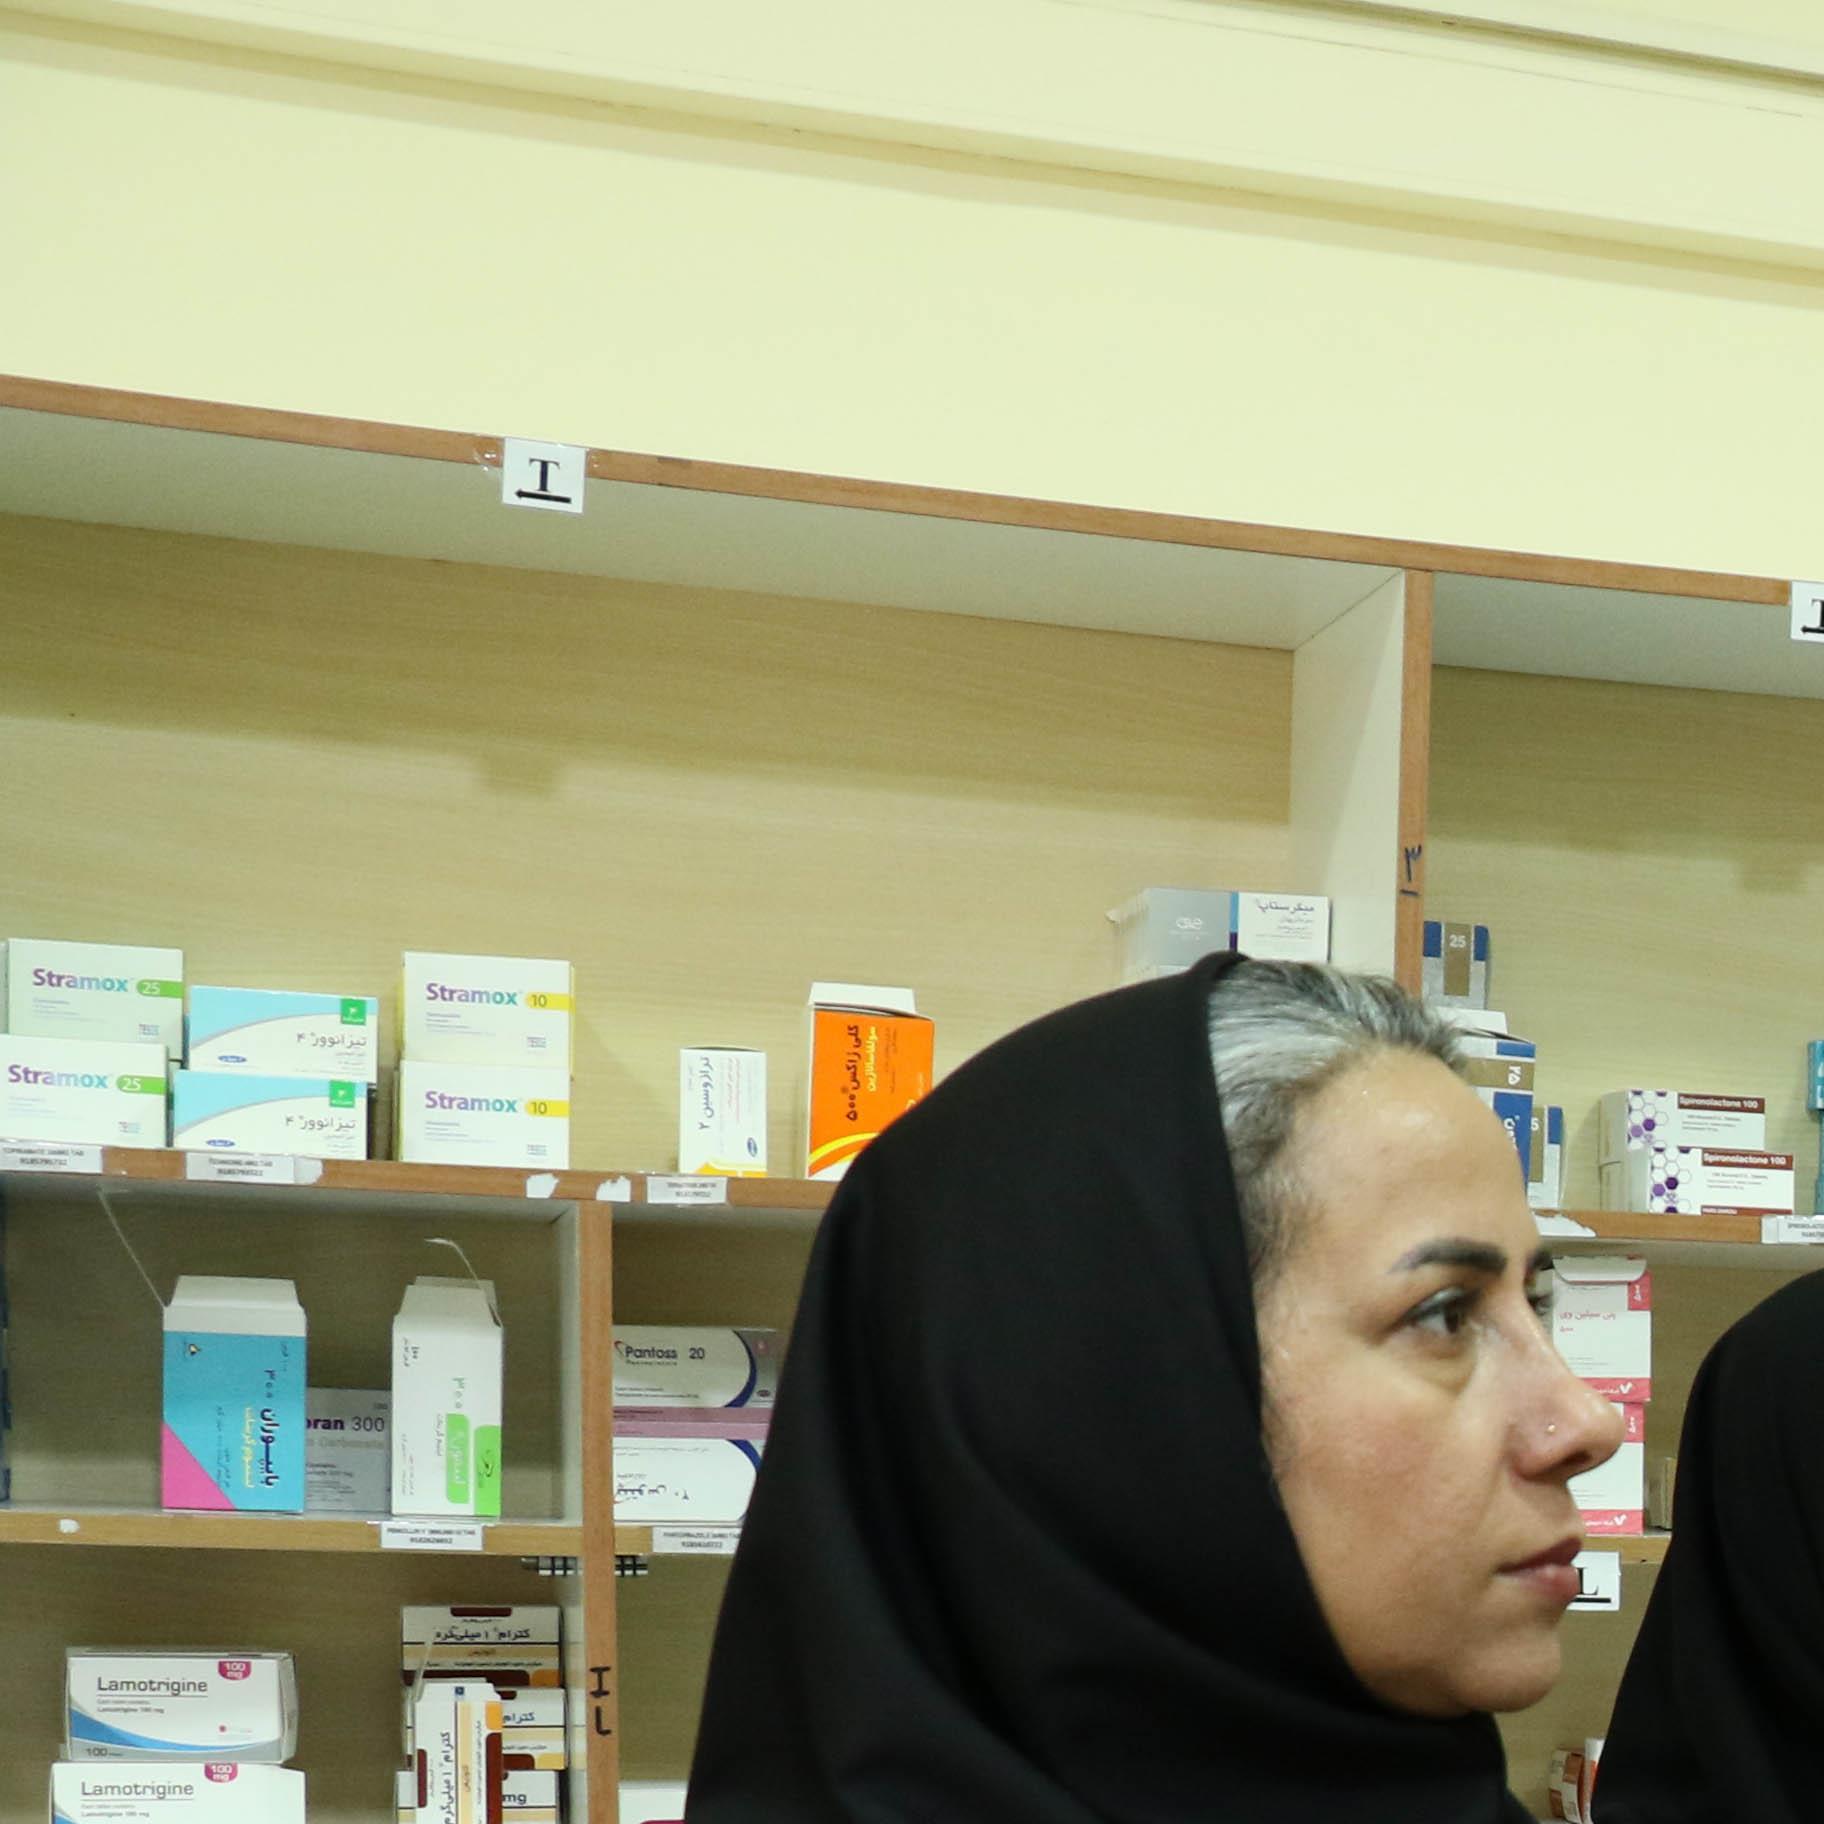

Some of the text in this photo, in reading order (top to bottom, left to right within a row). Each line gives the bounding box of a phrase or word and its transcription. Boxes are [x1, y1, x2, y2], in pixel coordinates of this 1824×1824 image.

[528, 456, 561, 492] T
[1448, 934, 1467, 948] 25
[32, 968, 161, 995] Stramox 25
[425, 982, 548, 1008] Stramox 10
[7, 1063, 142, 1091] Stramox 25
[424, 1090, 548, 1115] Stramox 10
[688, 1347, 706, 1360] 20
[351, 1416, 385, 1432] 300
[224, 1662, 246, 1672] 100
[96, 1676, 208, 1697] Lamotrigine
[85, 1747, 109, 1757] 100
[210, 1765, 233, 1774] 100
[80, 1781, 195, 1799] Lamotrigine
[502, 1792, 528, 1805] mg
